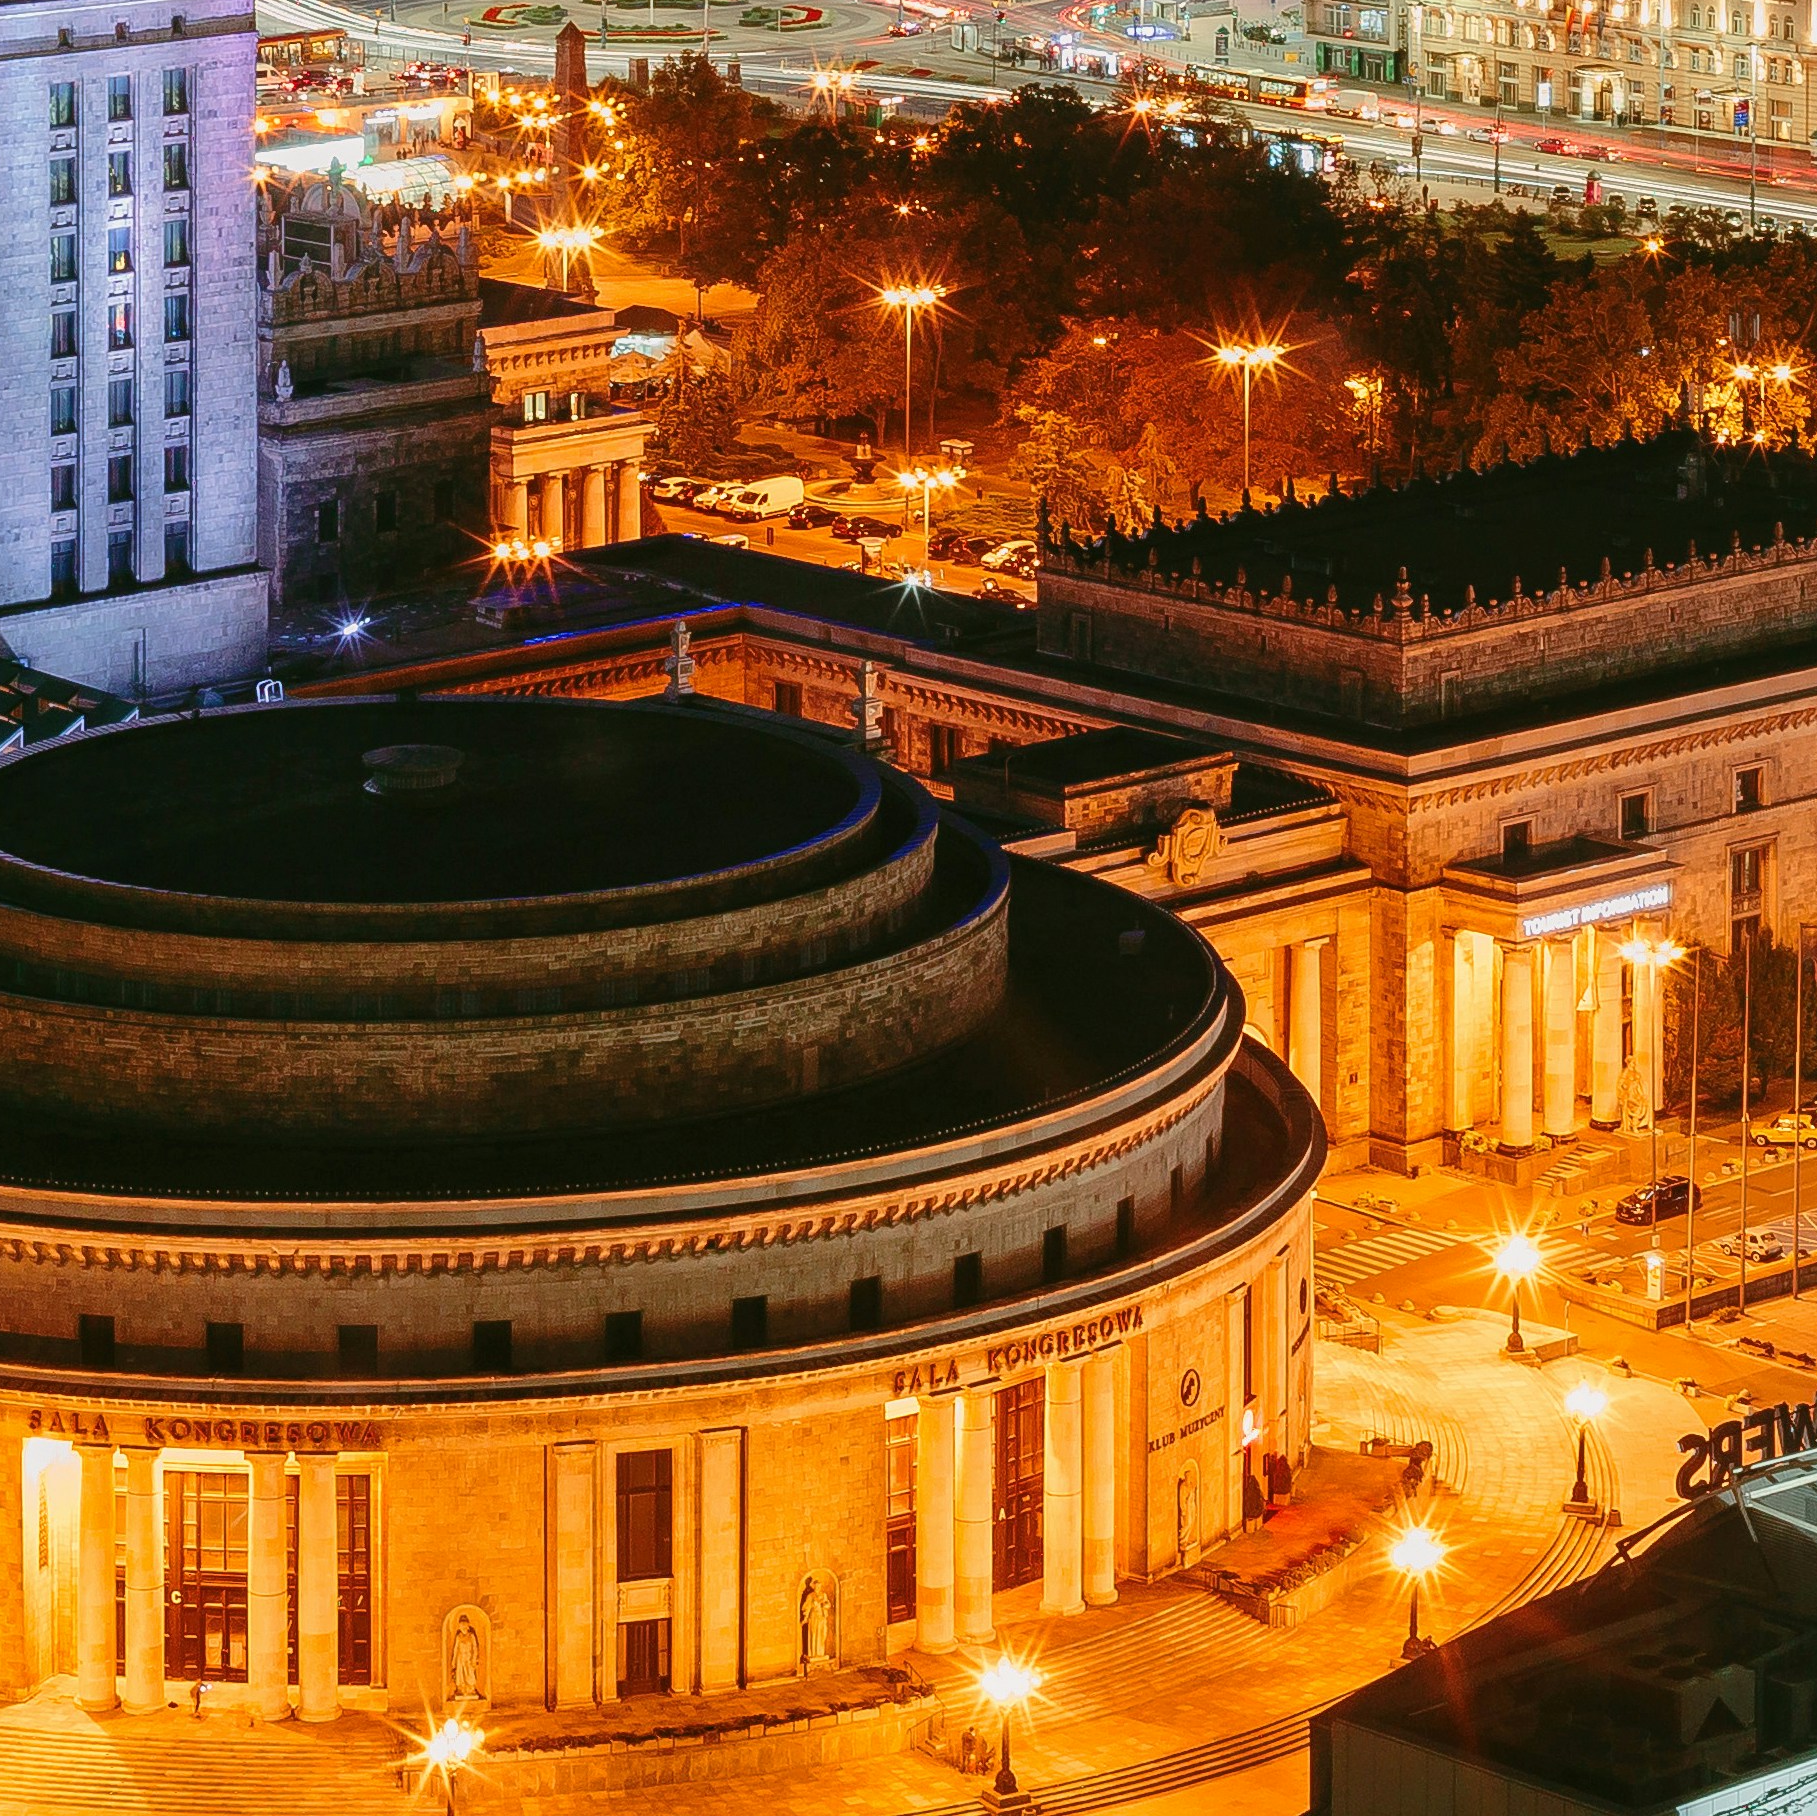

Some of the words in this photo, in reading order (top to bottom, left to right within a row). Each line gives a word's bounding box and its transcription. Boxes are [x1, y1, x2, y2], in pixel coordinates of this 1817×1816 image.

[1522, 907, 1581, 936] TOURIST
[1581, 887, 1669, 923] INFORMATION
[893, 1358, 960, 1393] SALA
[987, 1305, 1145, 1374] KONGRESOWA
[28, 1409, 110, 1437] SALA
[144, 1416, 383, 1446] KONGRESOWA
[1148, 1432, 1176, 1454] KLUB
[1179, 1405, 1226, 1439] MUZYCZNY
[171, 1590, 182, 1604] C
